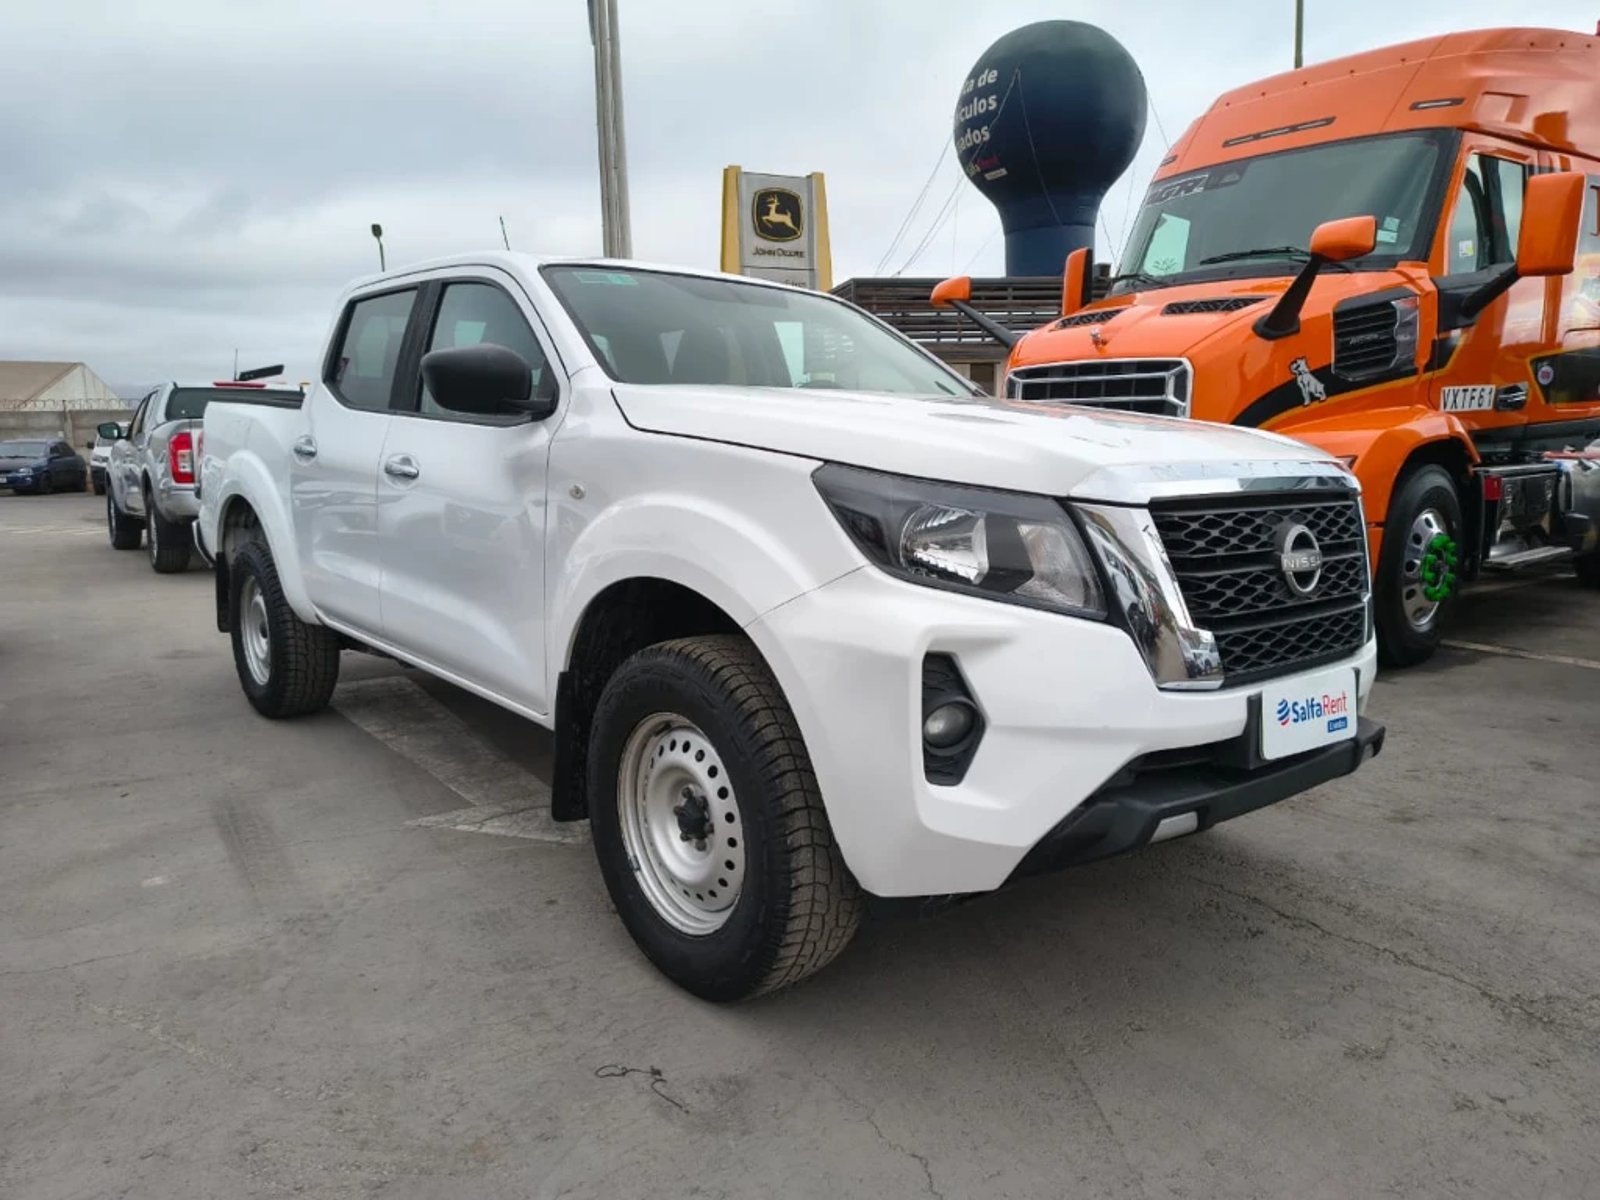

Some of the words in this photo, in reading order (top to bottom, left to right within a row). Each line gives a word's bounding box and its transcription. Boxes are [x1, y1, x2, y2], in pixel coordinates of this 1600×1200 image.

[977, 68, 998, 88] de
[958, 125, 991, 152] ados
[1443, 387, 1493, 409] VXTF61
[1291, 690, 1347, 723] SalfaRent
